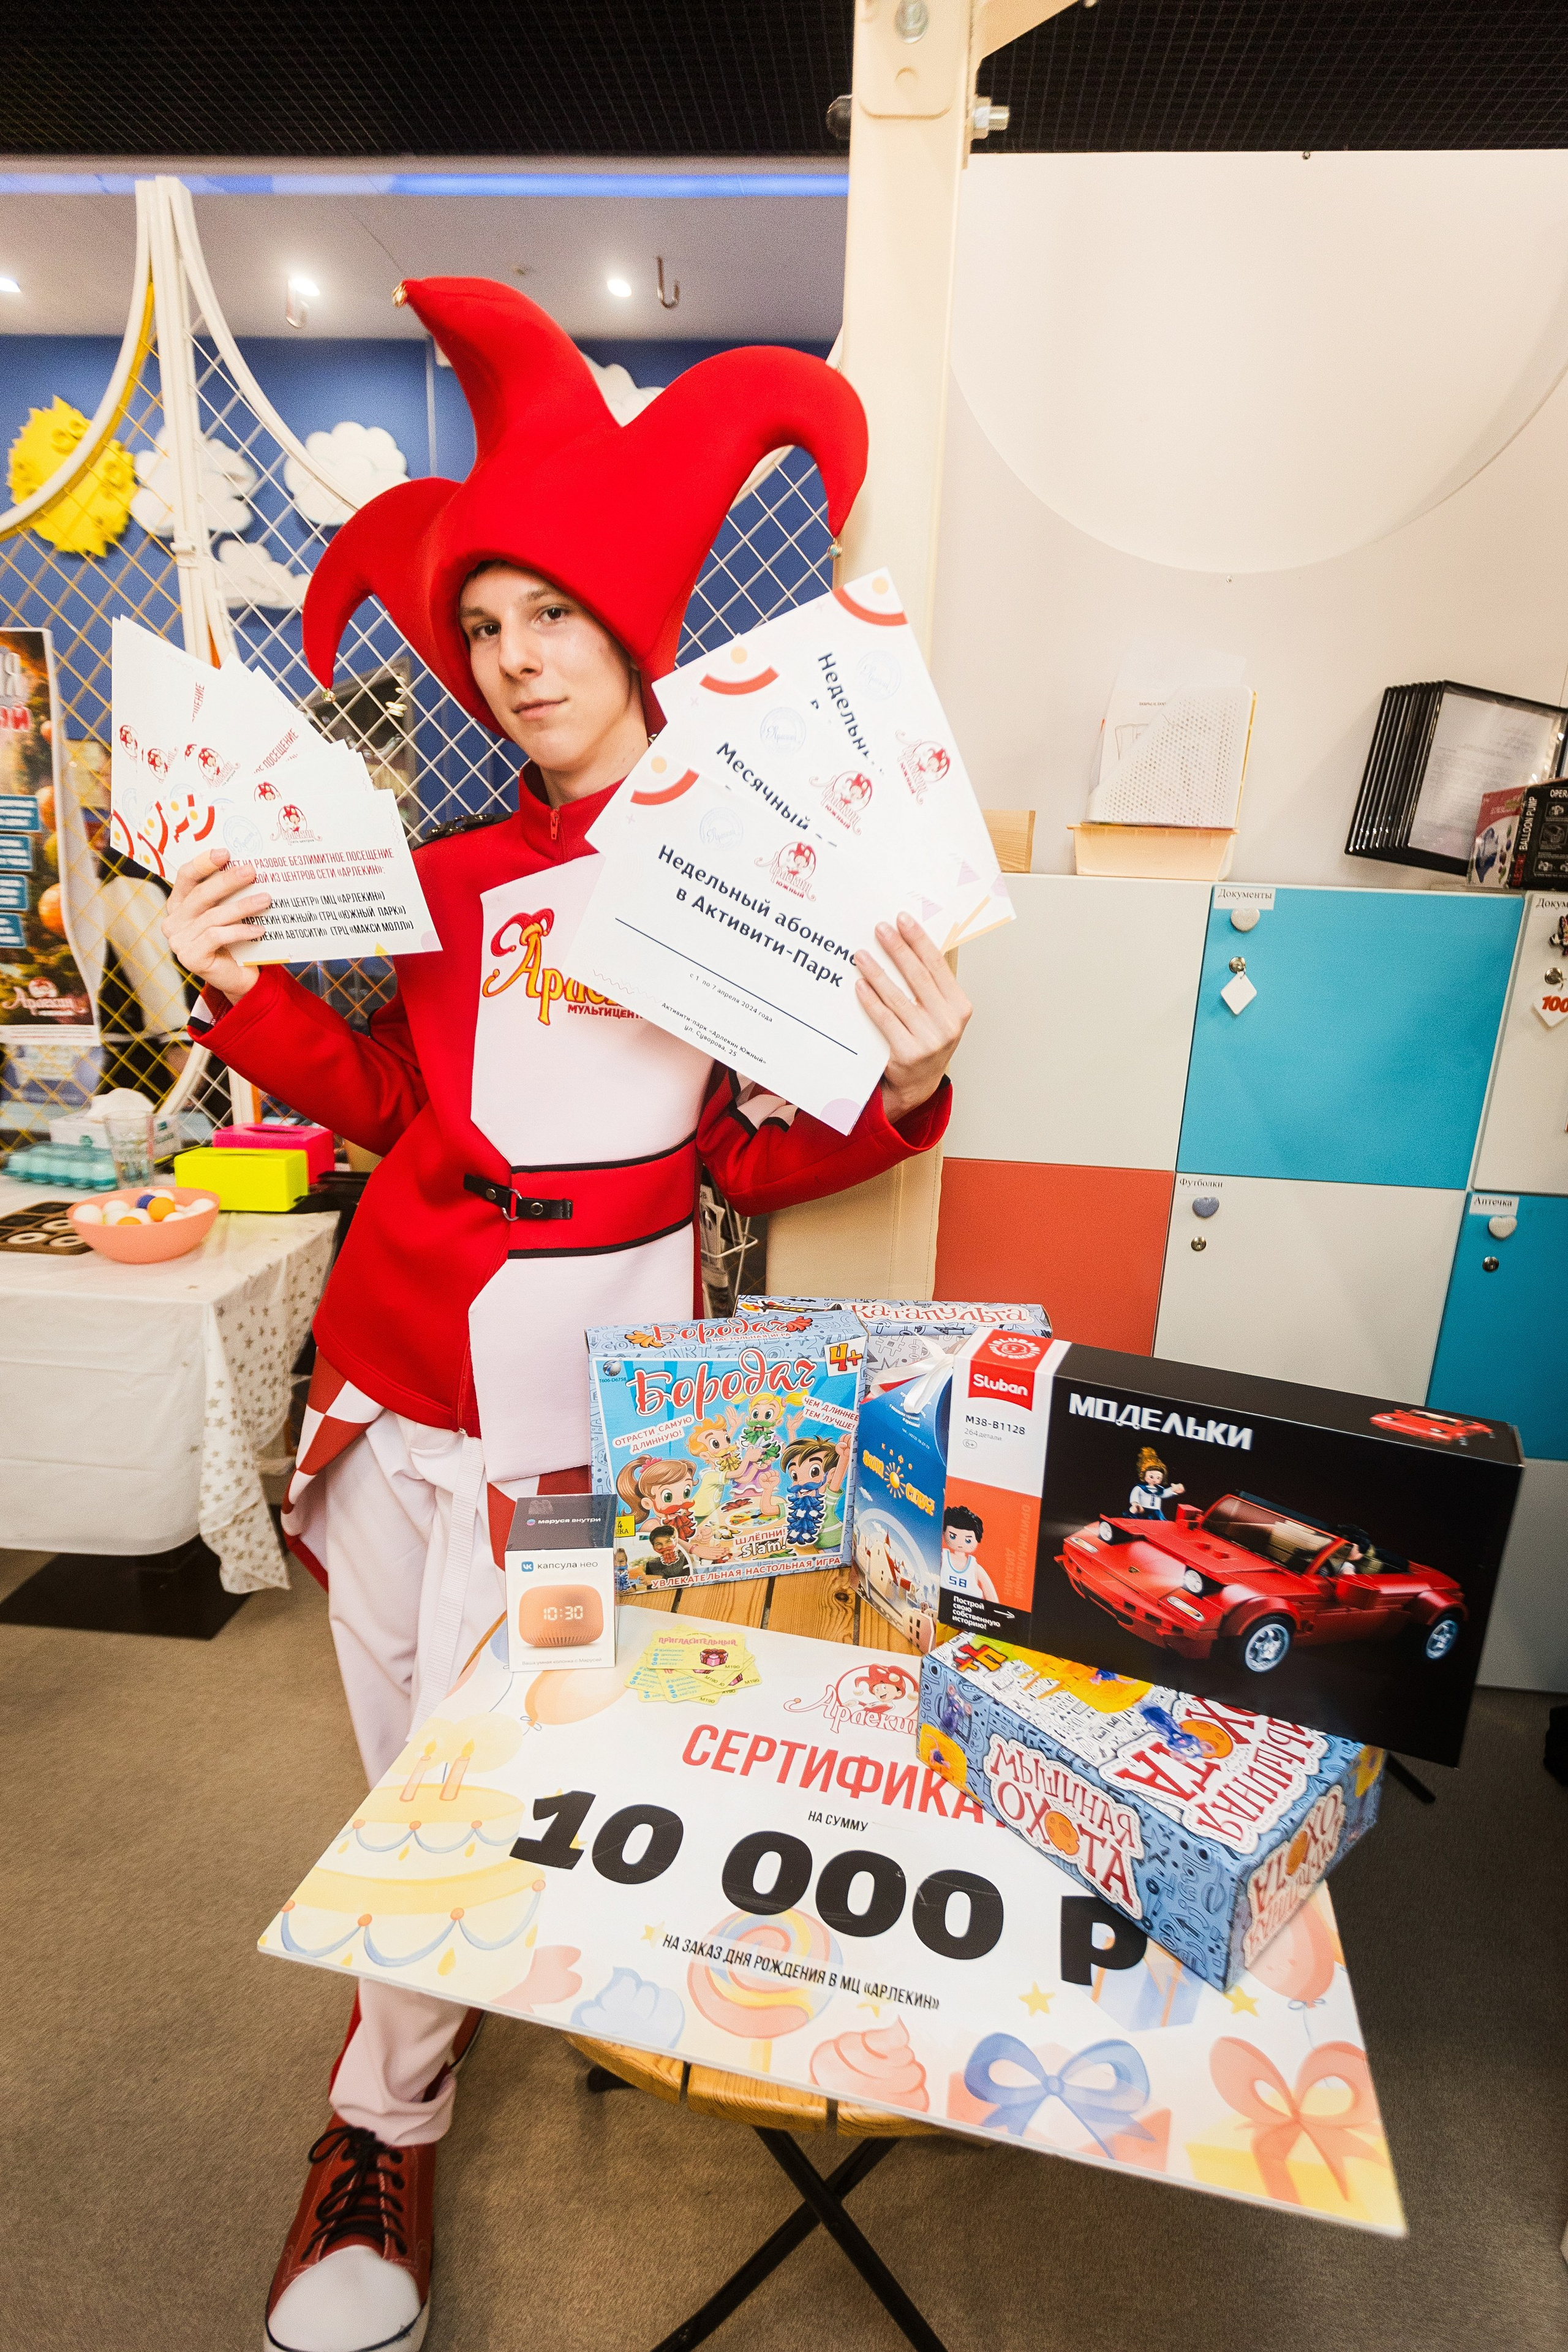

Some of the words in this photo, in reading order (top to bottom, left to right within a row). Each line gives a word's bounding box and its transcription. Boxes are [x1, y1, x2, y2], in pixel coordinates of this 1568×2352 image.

[263, 728, 300, 769] ПОСЕЩЕНИЕ
[717, 742, 811, 830] Месячный
[1526, 796, 1538, 818] PUMP
[1519, 817, 1534, 852] BALLOON
[254, 856, 287, 869] РАЗОВОЕ
[288, 851, 345, 868] БЕЗЛИМИТНОЕ
[346, 848, 394, 862] ПОСЕЩЕНИЕ
[271, 871, 281, 883] ИЗ
[282, 868, 315, 883] ЦЕНТРОВ
[317, 867, 336, 880] СЕТИ
[337, 864, 386, 878] «АРЛЕКИН»:
[658, 844, 771, 918] Недельный
[292, 895, 320, 908] ЦЕНТР»
[320, 895, 338, 907] (МЦ
[338, 891, 386, 903] «АРЛЕКИН»)
[775, 880, 805, 899] ЮЖНЫЙ
[1218, 889, 1273, 900] Документы
[282, 910, 318, 925] ЮЖНЫЙ»
[319, 910, 337, 922] (ТРЦ
[337, 906, 375, 920] «ЮЖНЫЙ
[378, 905, 407, 918] ПАРК»)
[286, 924, 328, 940] АВТОСИТИ»
[330, 922, 350, 936] (ТРЦ
[350, 922, 382, 935] «МАКСИ
[382, 920, 415, 933] МОЛЛ»)
[676, 888, 687, 902] в
[692, 895, 844, 988] Активити-Парк
[717, 988, 740, 1003] апреля
[741, 1001, 758, 1014] 2024
[758, 1011, 773, 1023] года
[662, 1002, 707, 1031] Активити-парк
[709, 1029, 739, 1049] «Арлекин
[739, 1045, 767, 1065] Южный»
[684, 1025, 694, 1033] ул.
[696, 1030, 726, 1052] Суворова,
[1180, 1178, 1223, 1188] Футболки
[1474, 1196, 1512, 1207] Аптечка
[652, 1317, 789, 1346] Бородач
[712, 1333, 771, 1342] НАСТОЛЬНАЯ
[626, 1348, 818, 1422] Бородач
[973, 1373, 1029, 1397] Sluban
[804, 1397, 821, 1409] ЧЕМ
[821, 1403, 859, 1422] ДЛИННЕЕ
[805, 1408, 821, 1420] ТЕМ
[822, 1414, 857, 1431] ЛУЧШЕ!
[615, 1428, 655, 1447] ОТРАСТИ
[658, 1415, 693, 1433] САМУЮ
[964, 1428, 979, 1436] 264
[965, 1415, 1026, 1436] M38-B1128
[1069, 1393, 1253, 1451] МОДЕЛЬКИ
[632, 1430, 684, 1453] ДЛИННУЮ!
[538, 1518, 570, 1528] маруся
[735, 1529, 786, 1546] ШЛЁПНИ!
[741, 1536, 787, 1558] Slam!
[537, 1561, 578, 1570] капсула
[651, 1569, 742, 1589] УВЛЕКАТЕЛЬНАЯ
[745, 1559, 814, 1577] НАСТОЛЬНАЯ
[815, 1556, 842, 1567] ИГРА
[543, 1605, 583, 1621] 10:30
[953, 1603, 973, 1613] свою
[954, 1596, 986, 1611] Построй
[952, 1610, 1001, 1628] собственную
[952, 1616, 987, 1630] историю!
[658, 1637, 738, 1646] ПРИГЛАСИТЕЛЬНЫЙ
[682, 1724, 1006, 1828] СЕРТИФИКА
[990, 1743, 1136, 1850] МЫШИНАЯ
[808, 1811, 823, 1823] НА
[825, 1814, 869, 1833] СУММУ
[509, 1790, 684, 1885] 10
[722, 1830, 1004, 1960] 000
[662, 1934, 679, 1951] НА
[681, 1938, 723, 1960] ЗАКАЗ
[722, 1948, 753, 1967] ДНЯ
[753, 1955, 826, 1985] РОЖДЕНИЯ
[829, 1972, 837, 1986] В
[839, 1975, 862, 1995] МЦ
[863, 1982, 940, 2010] «АРЛЕКИН»
